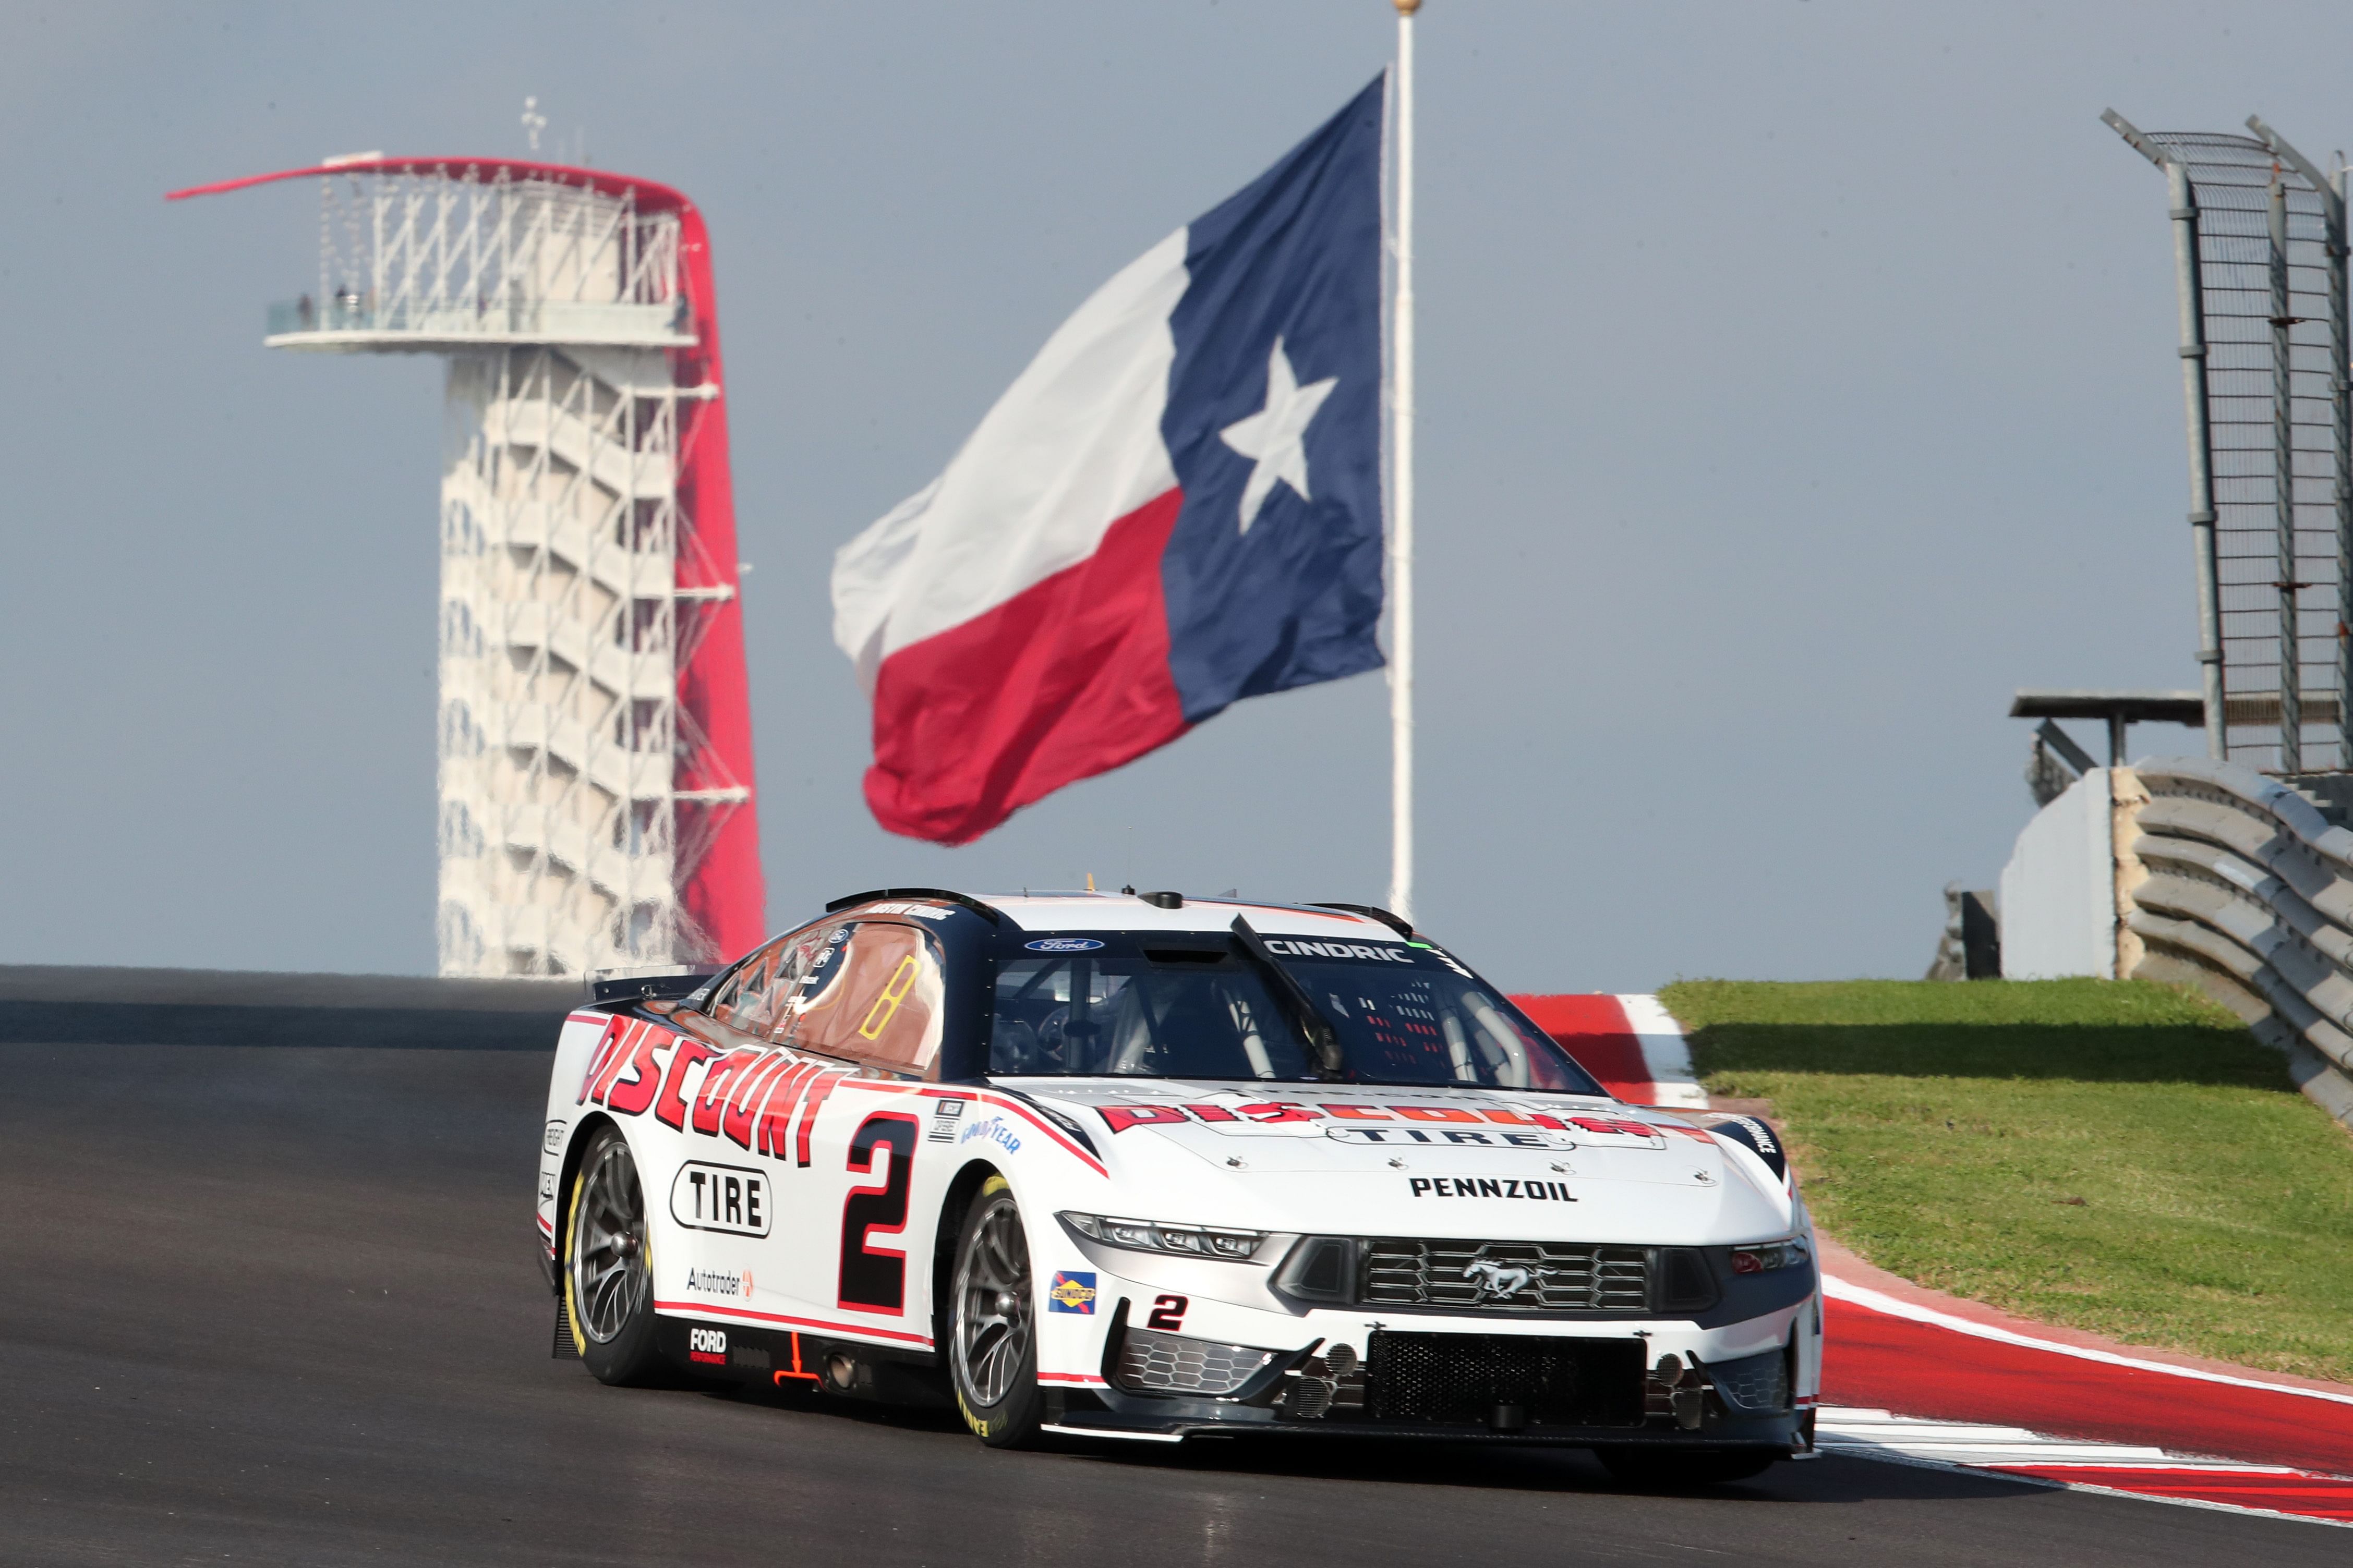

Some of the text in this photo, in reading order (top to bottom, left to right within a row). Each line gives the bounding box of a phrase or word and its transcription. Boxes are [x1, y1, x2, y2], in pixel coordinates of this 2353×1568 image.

[1040, 940, 1089, 949] Ford
[1263, 940, 1415, 963] CINDRIC
[575, 1014, 851, 1168] DISCOUNT
[1093, 1101, 1717, 1145] DISCOUNT
[1345, 1128, 1551, 1148] TIRE
[690, 1171, 762, 1227] TIRE
[1408, 1177, 1579, 1202] PENNZOIL
[837, 1110, 920, 1317] 2
[686, 1267, 740, 1296] Autotrader
[1053, 1287, 1094, 1300] SUNOCO
[1147, 1294, 1188, 1332] 2
[690, 1328, 727, 1353] FORD
